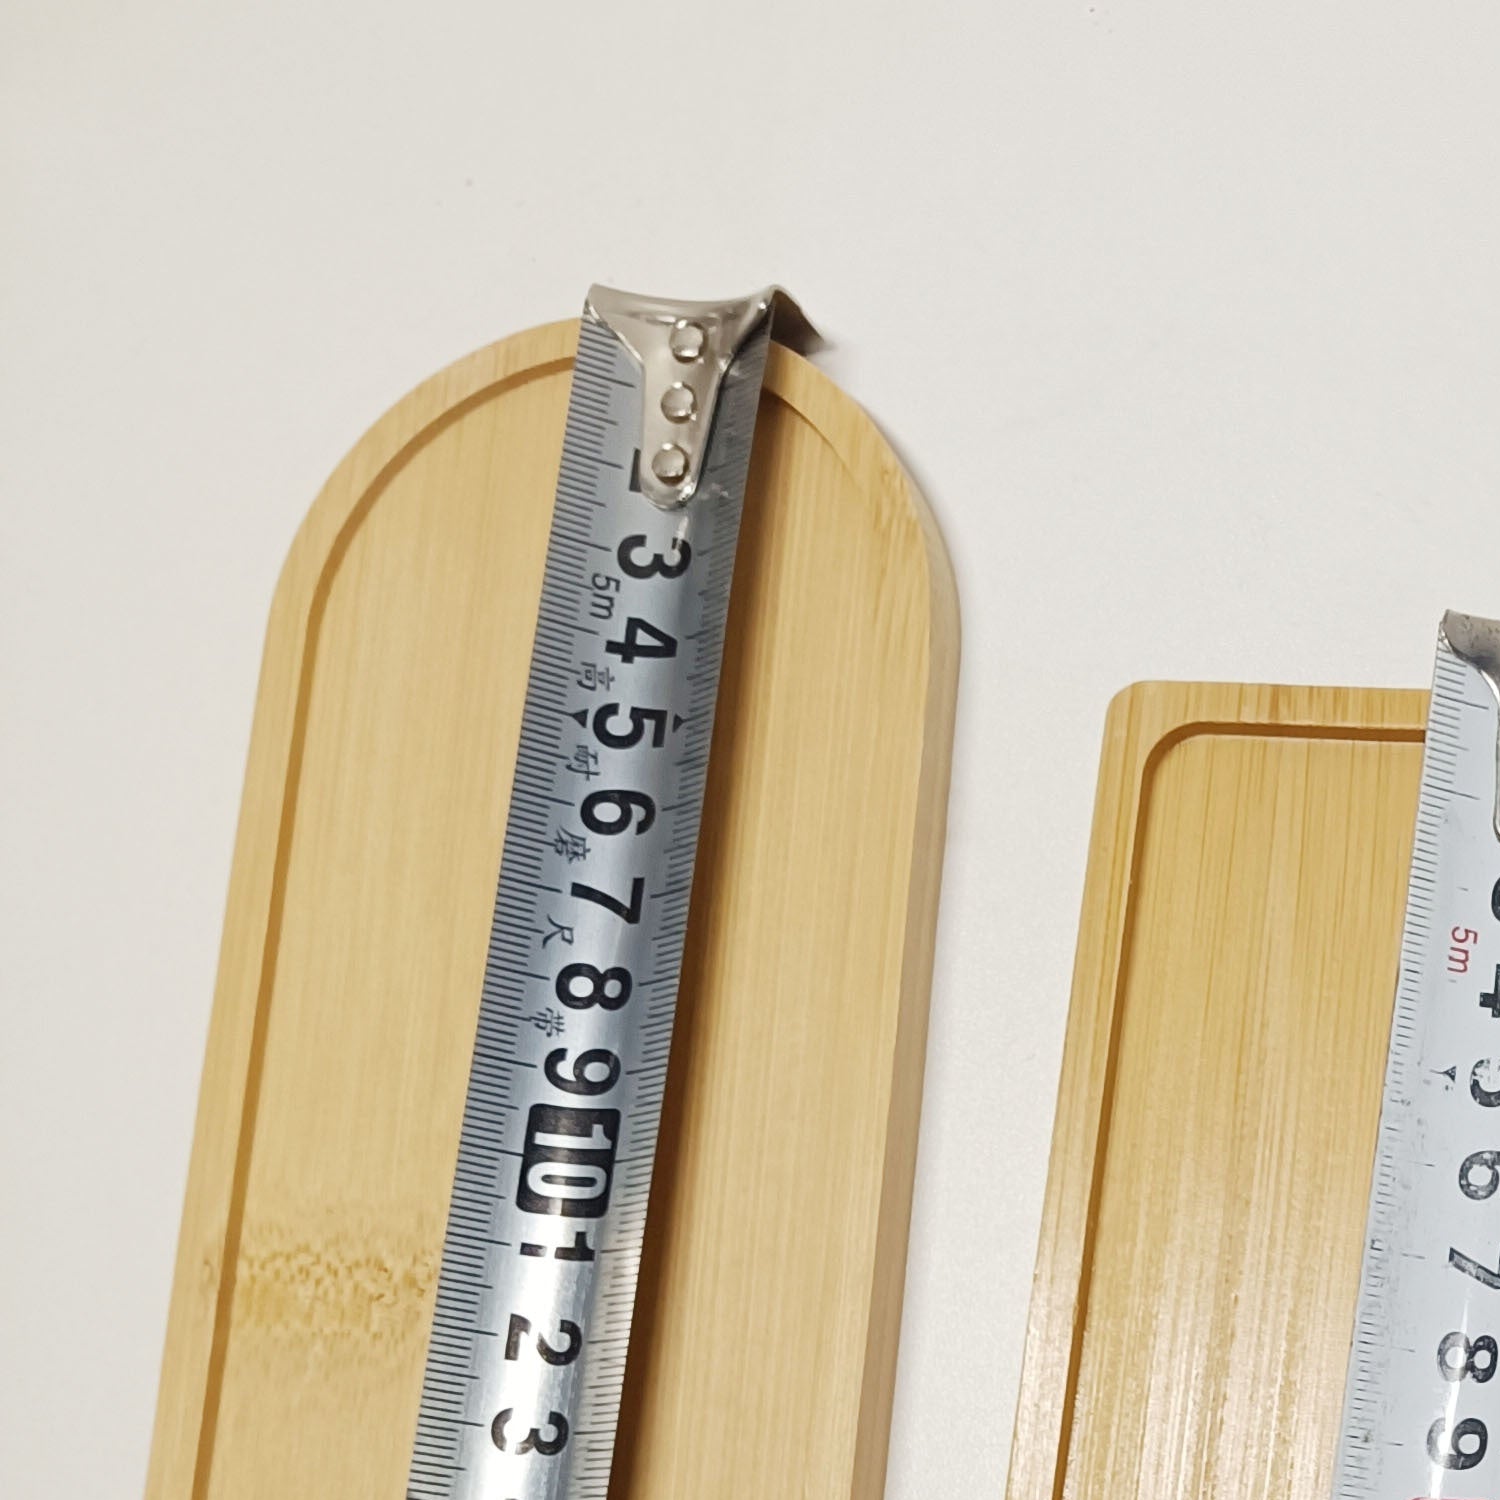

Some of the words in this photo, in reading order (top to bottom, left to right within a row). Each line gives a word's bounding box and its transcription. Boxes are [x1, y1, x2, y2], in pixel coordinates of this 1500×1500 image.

[617, 534, 692, 580] 3
[589, 572, 621, 620] 5m
[604, 617, 678, 664] 4
[592, 702, 667, 749] 5
[580, 789, 656, 836] 6
[570, 877, 645, 924] 7
[1447, 926, 1478, 974] 5m
[555, 962, 633, 1012] 8
[543, 1047, 621, 1096] 9
[526, 1123, 607, 1201] 10
[518, 1231, 595, 1262] 1
[504, 1313, 582, 1366] 2
[1436, 1331, 1499, 1384] 8
[491, 1407, 570, 1457] 3
[1426, 1417, 1488, 1470] 9
